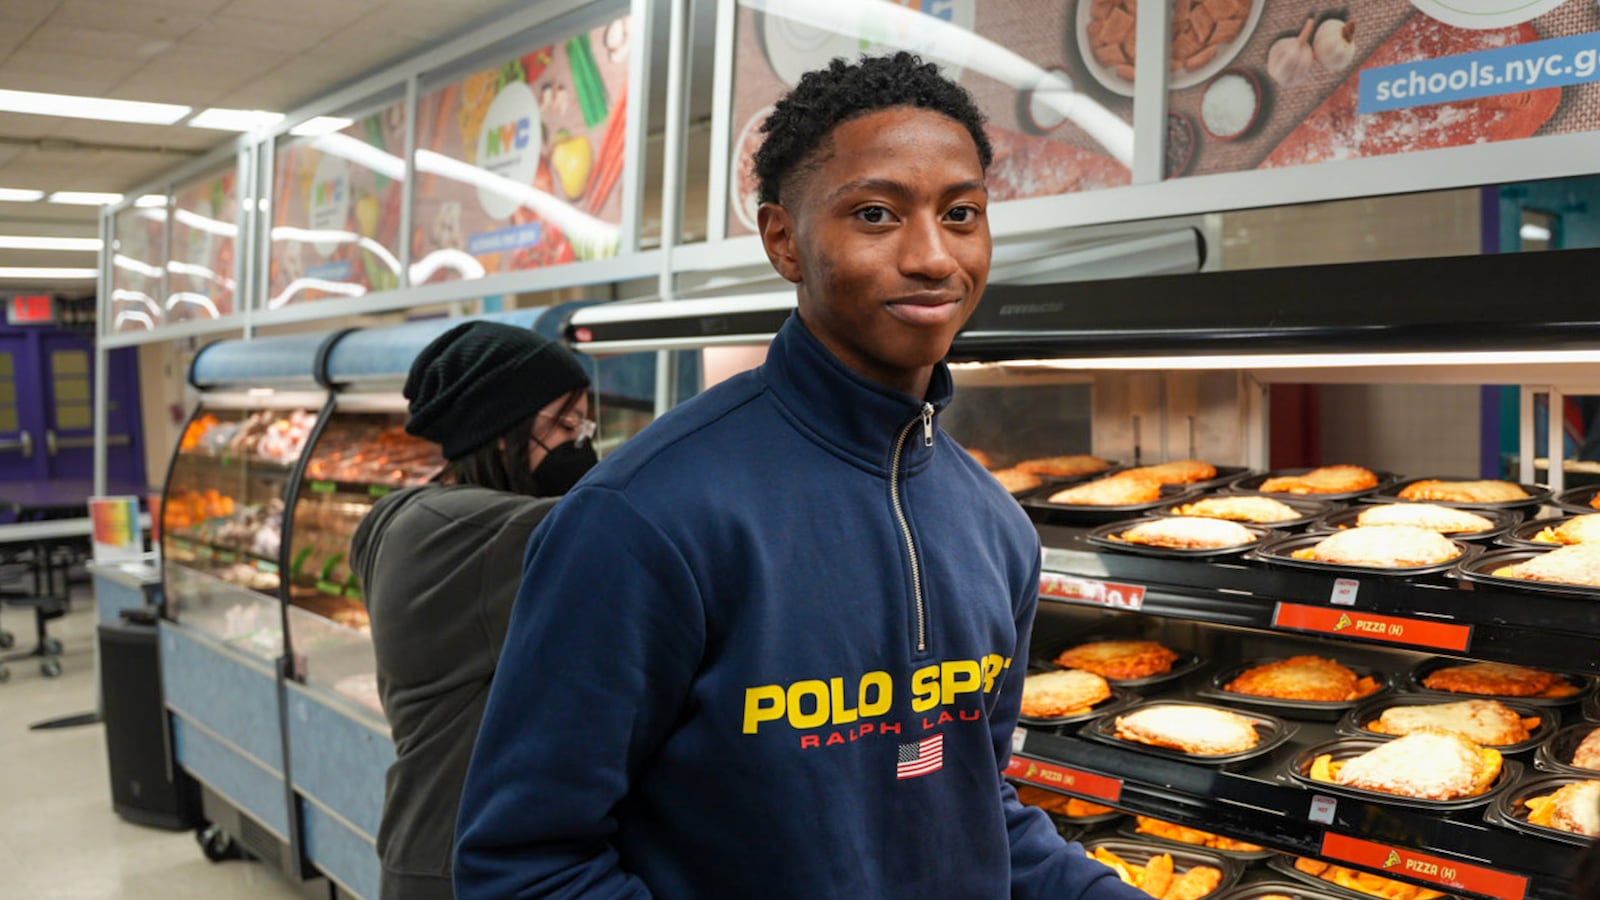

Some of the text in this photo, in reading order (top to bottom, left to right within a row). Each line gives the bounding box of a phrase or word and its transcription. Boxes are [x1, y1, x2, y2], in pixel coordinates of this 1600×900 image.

[1375, 47, 1600, 101] schools.nyc.g
[486, 117, 530, 159] NYC
[1355, 619, 1404, 637] PIZZA (H)
[742, 653, 1012, 734] POLO SPR
[800, 722, 901, 749] RALPH
[1405, 858, 1457, 882] PIZZA (H)
